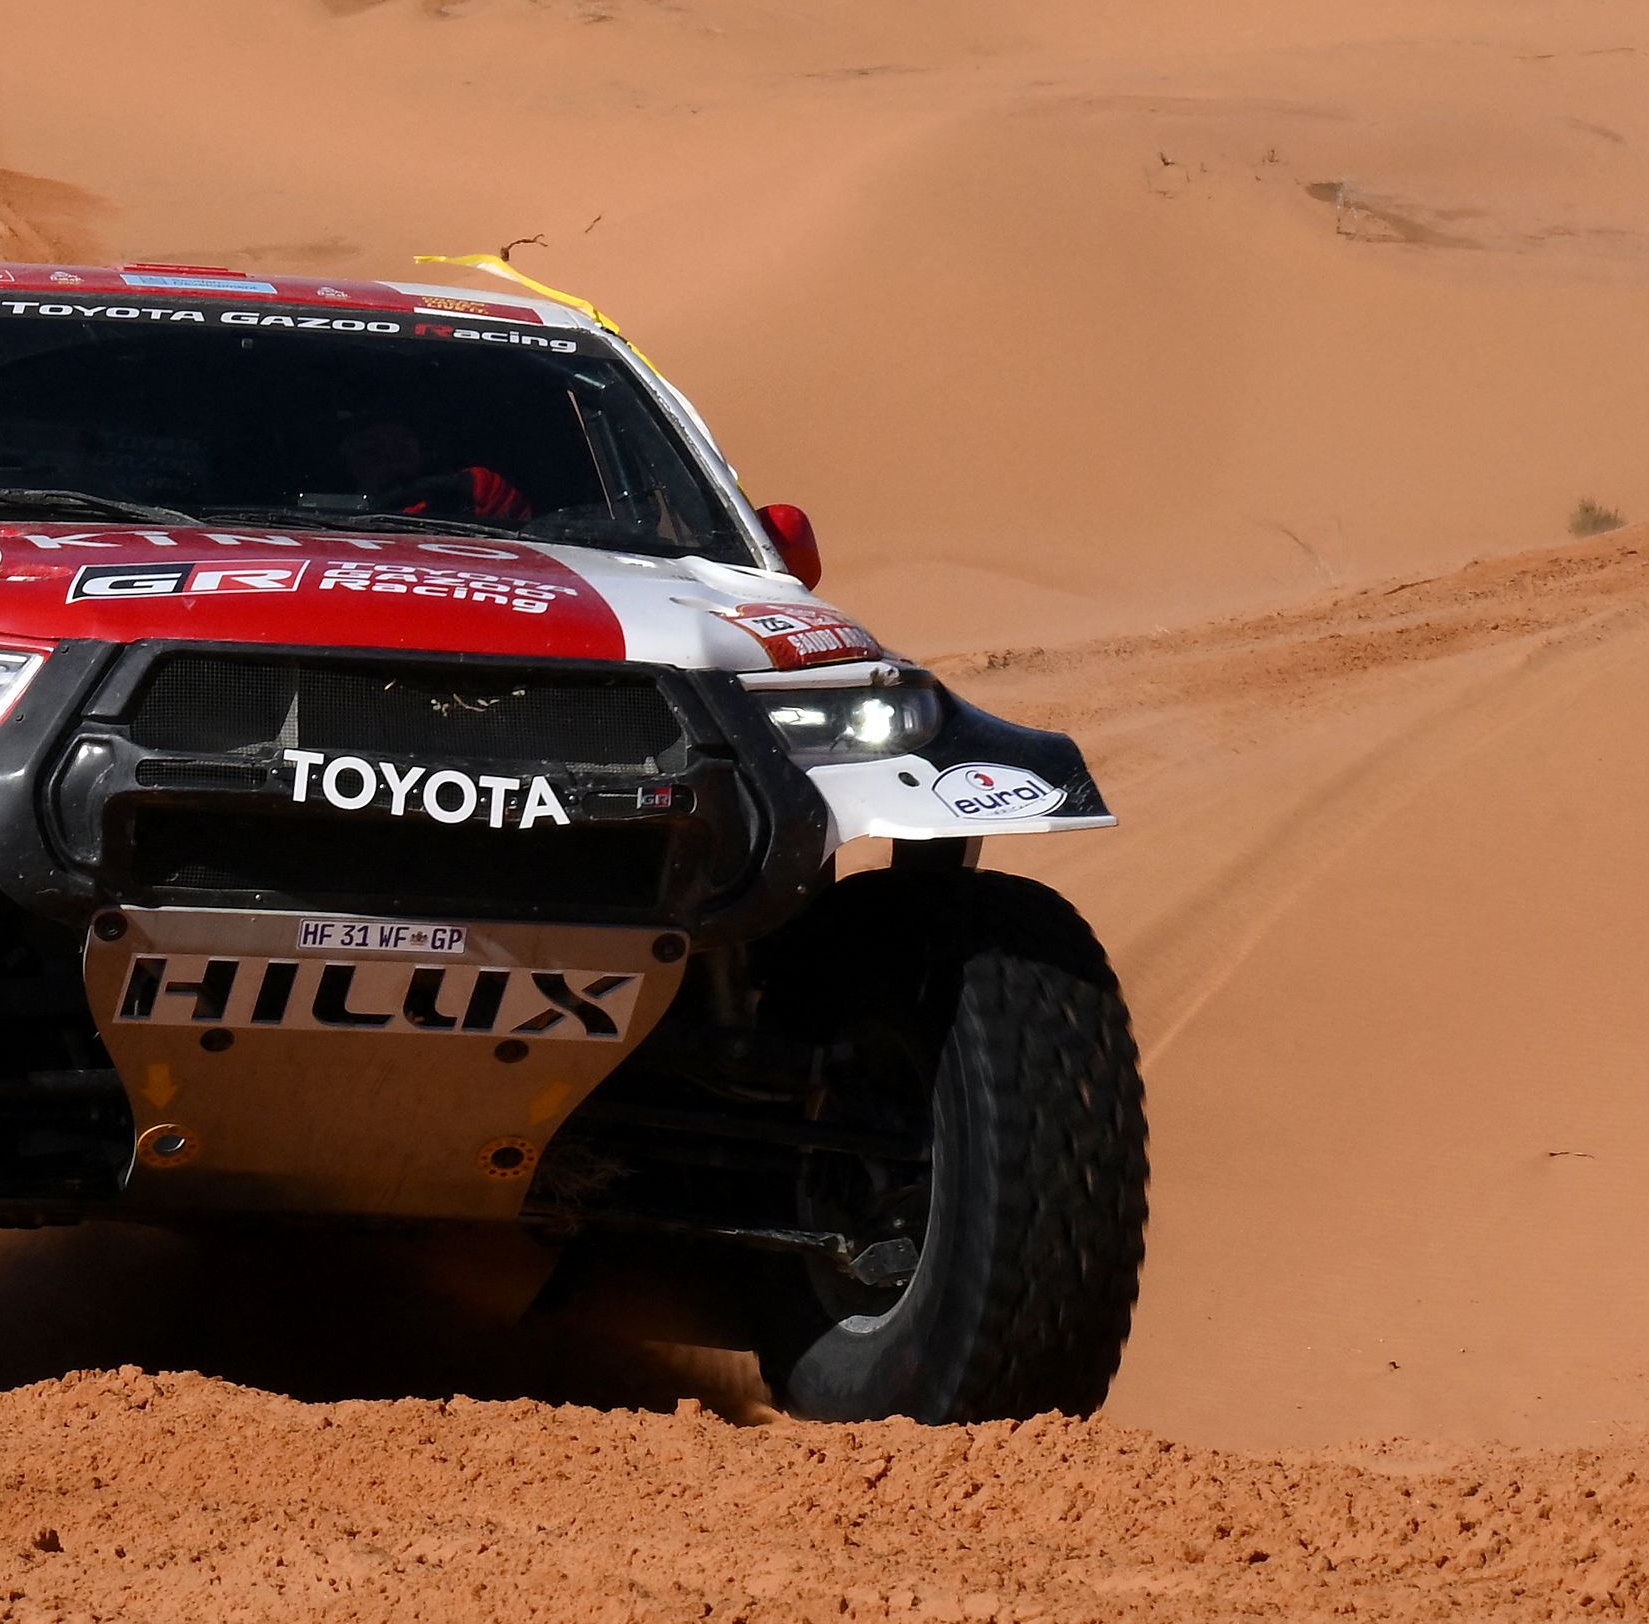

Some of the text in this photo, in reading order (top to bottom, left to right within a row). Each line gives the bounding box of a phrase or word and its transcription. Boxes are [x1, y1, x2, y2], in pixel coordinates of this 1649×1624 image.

[1, 300, 205, 323] TOYOTA
[220, 311, 401, 334] GAZOO
[414, 323, 578, 354] Racing
[80, 561, 579, 597] GR TOYOTA
[318, 578, 549, 615] Racing
[323, 568, 557, 601] GAZOO
[282, 748, 571, 830] TOYOTA
[954, 779, 1048, 814] eurol
[302, 923, 463, 950] HF 31 WF GP
[120, 955, 637, 1038] HILUX
